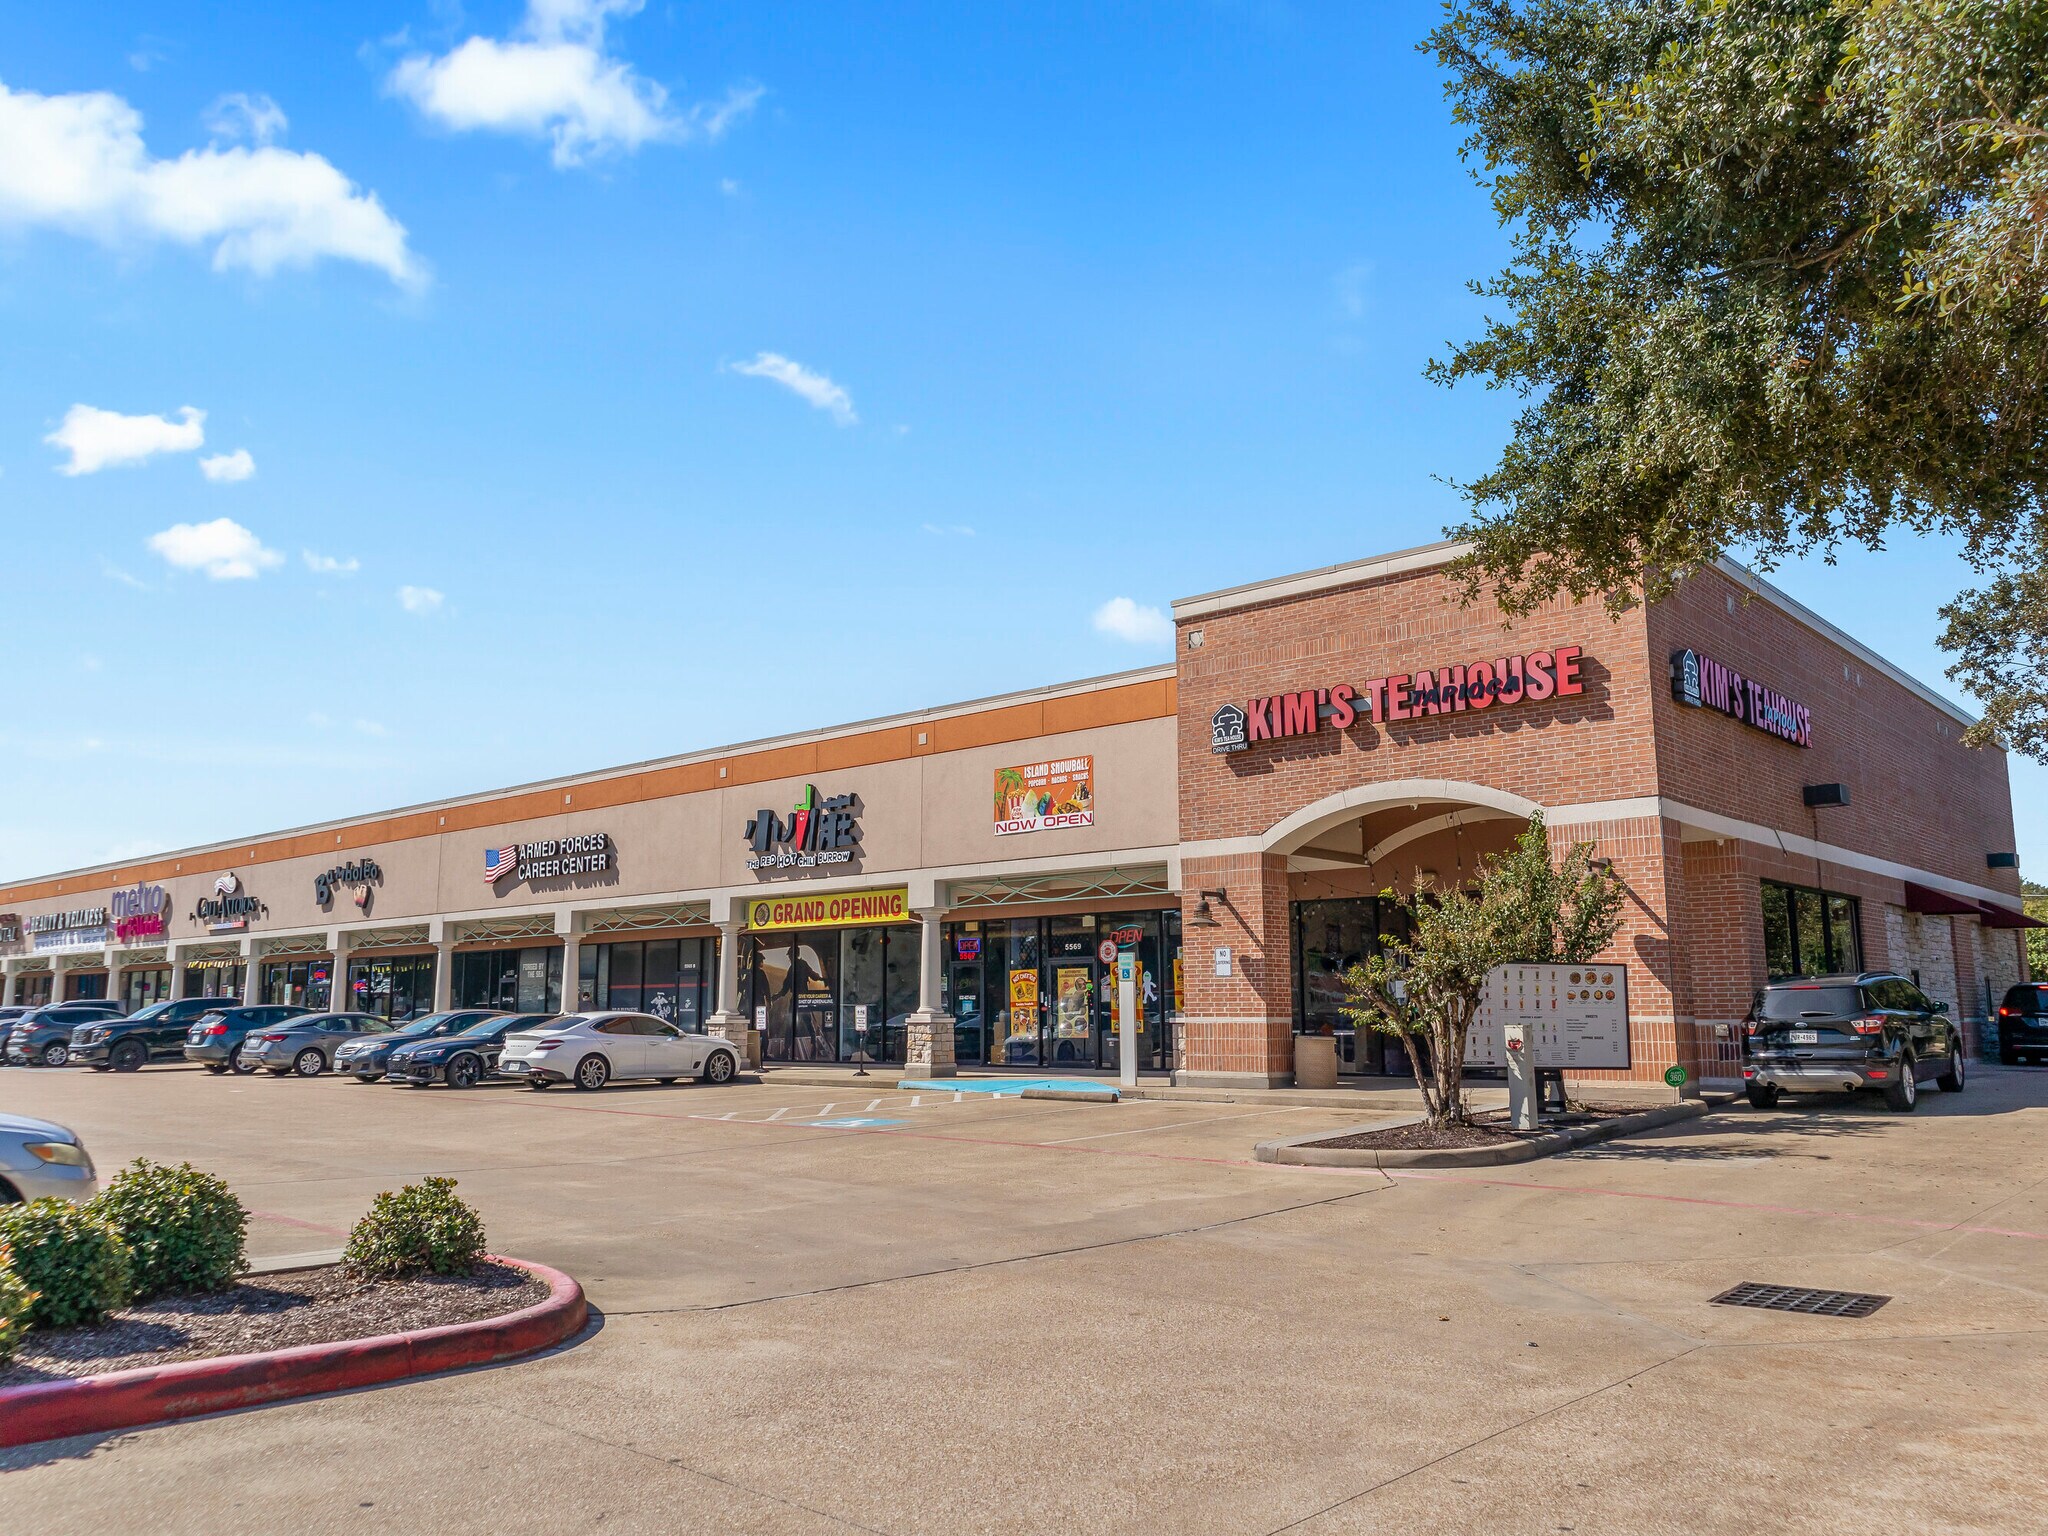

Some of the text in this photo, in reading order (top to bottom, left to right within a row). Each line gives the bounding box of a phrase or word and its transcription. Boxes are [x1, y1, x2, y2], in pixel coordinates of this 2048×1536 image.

[1248, 646, 1583, 741] KIM'S TEAHOUSE
[1413, 675, 1521, 707] TAPIOCA
[1700, 655, 1812, 748] KIM'S TEAHOUSE
[1764, 705, 1797, 735] TAPIOCA
[1212, 742, 1248, 754] DRIVE THRU
[1024, 757, 1090, 779] ISLAND SNOWBALL
[1027, 771, 1089, 788] POPCORN NACHOS SNACKS
[995, 812, 1093, 834] NOW OPEN
[519, 833, 605, 861] ARMED FORCES
[518, 853, 606, 880] CAREER CENTER
[746, 851, 851, 871] THE RED HOT CHILI BURROW
[112, 881, 165, 918] metro
[773, 894, 902, 925] GRAND OPENING
[30, 913, 58, 933] BEAUTY
[65, 907, 104, 928] WELLNESS
[959, 940, 979, 951] OPEN
[1110, 928, 1143, 943] OPEN
[1064, 943, 1082, 951] 5569
[1219, 950, 1227, 958] NO
[535, 970, 544, 978] SEA
[1669, 1074, 1682, 1082] 360
